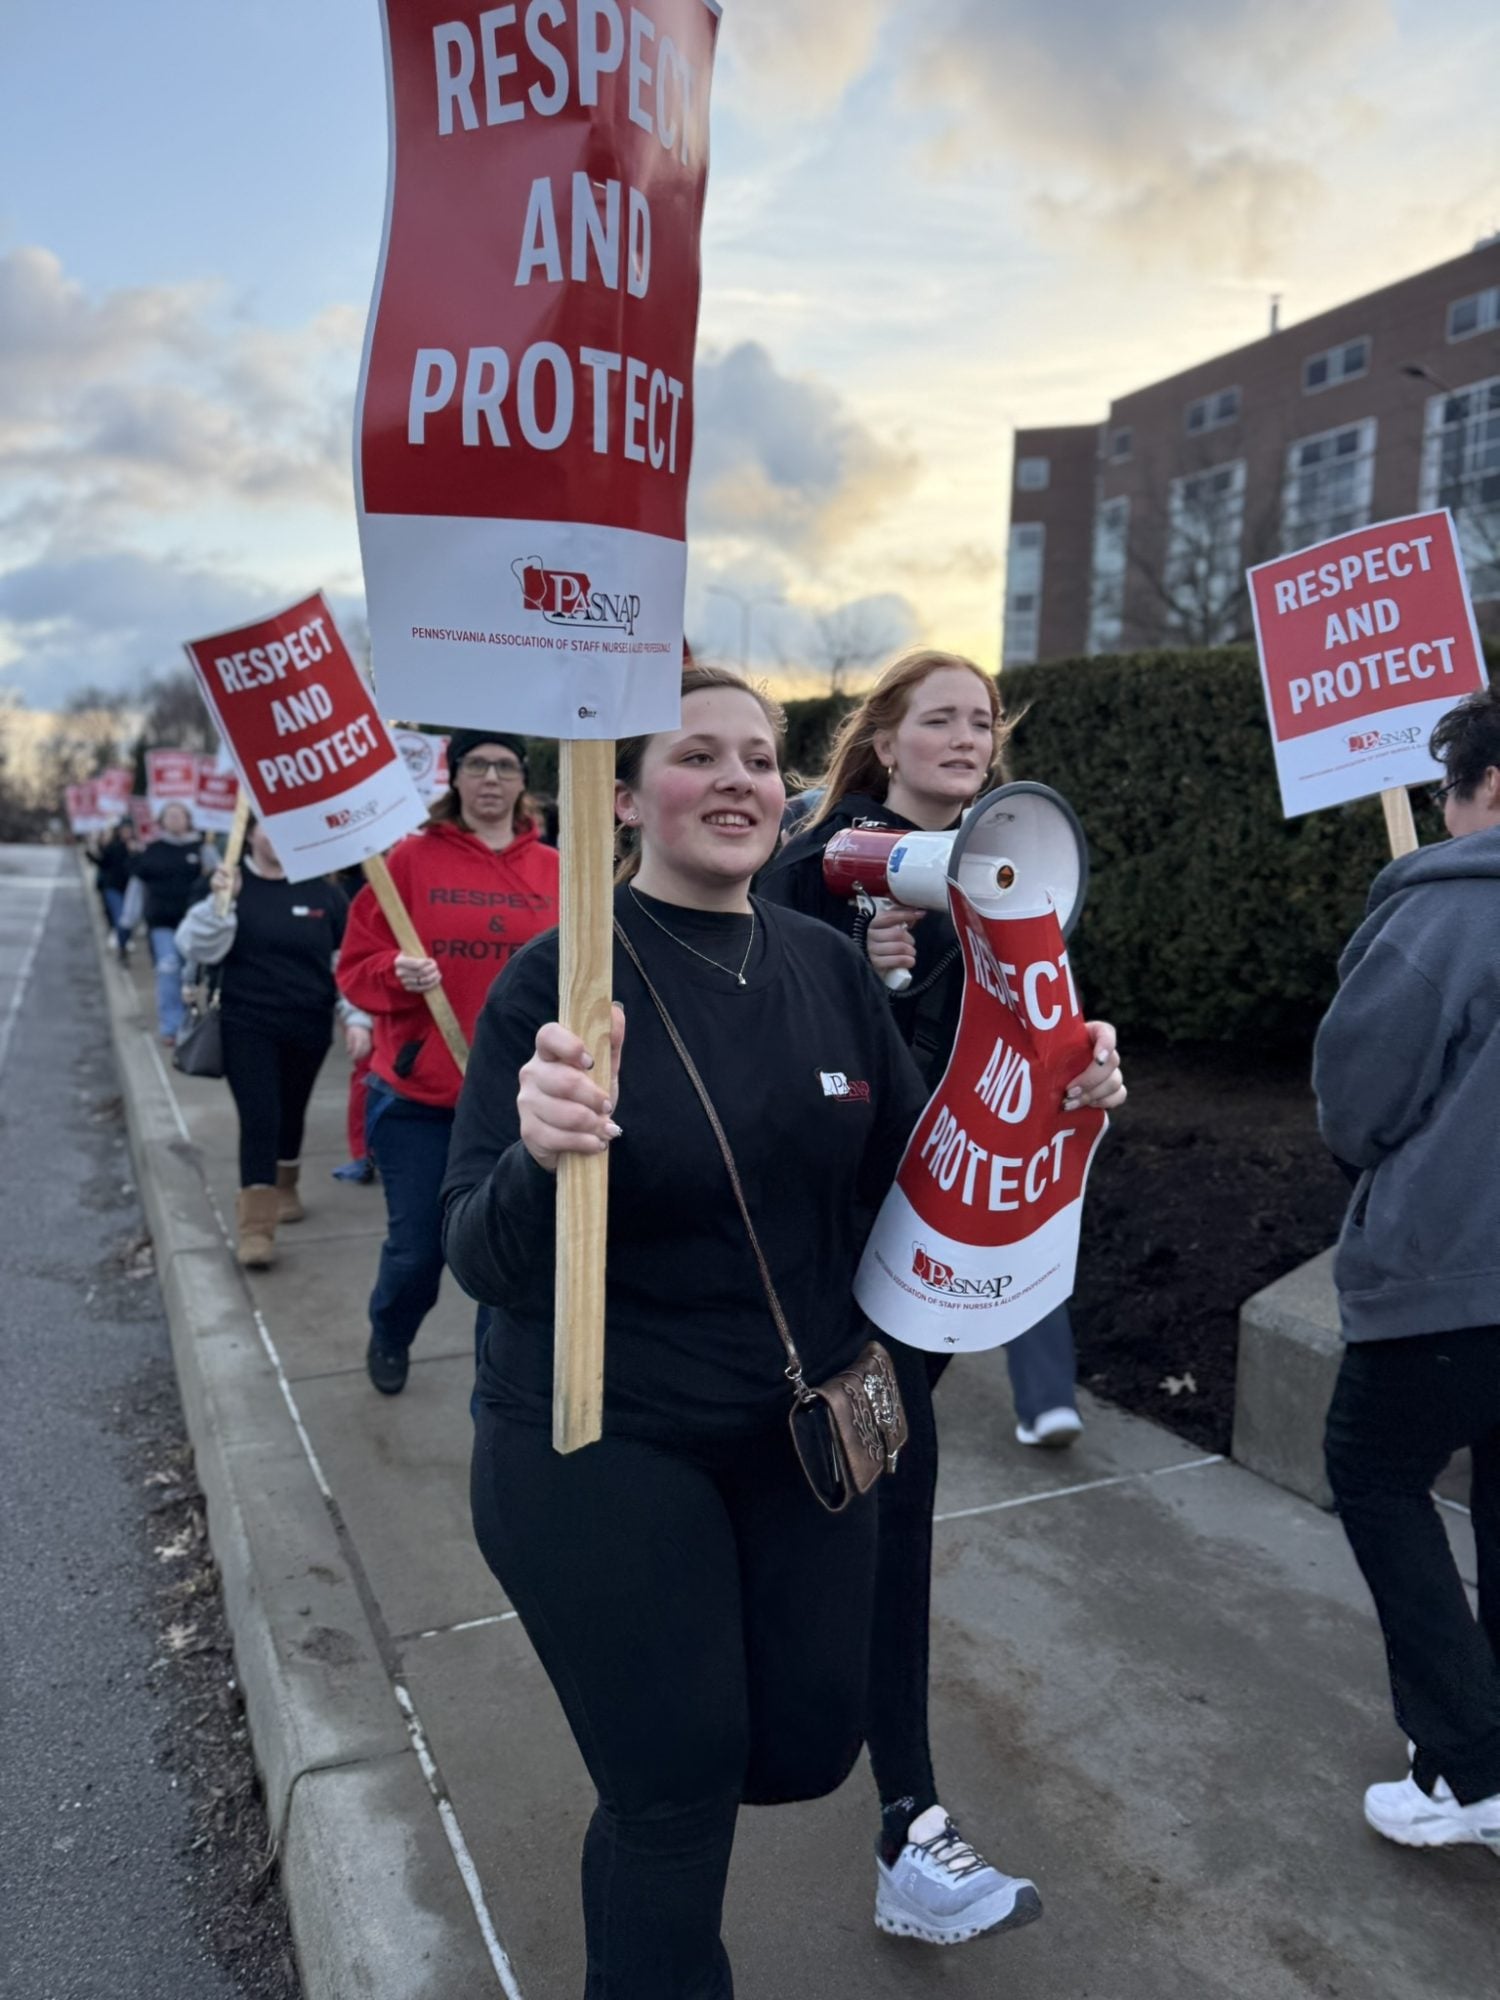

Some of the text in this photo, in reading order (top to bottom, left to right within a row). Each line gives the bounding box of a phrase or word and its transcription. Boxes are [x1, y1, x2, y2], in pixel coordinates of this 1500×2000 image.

[432, 0, 694, 165] RESPECT
[514, 171, 652, 299] AND
[408, 341, 684, 474] PROTECT
[549, 573, 641, 636] PASNAP
[1274, 535, 1433, 614] RESPECT
[214, 617, 333, 694] RESPECT
[412, 626, 486, 643] PENNSYLVANIA
[488, 633, 553, 649] ASSOCIATION
[555, 639, 569, 650] OF
[571, 639, 600, 652] STAFF
[1324, 598, 1400, 650] AND
[270, 683, 333, 736] AND
[1289, 637, 1455, 714] PROTECT
[257, 714, 379, 793] PROTECT
[488, 914, 505, 933] &
[974, 1037, 1032, 1125] AND
[920, 1104, 1076, 1211] PROTECT
[927, 1259, 1013, 1299] PASNAP
[927, 1296, 938, 1305] OF
[938, 1300, 962, 1310] STAFF
[963, 1302, 993, 1311] NURSES
